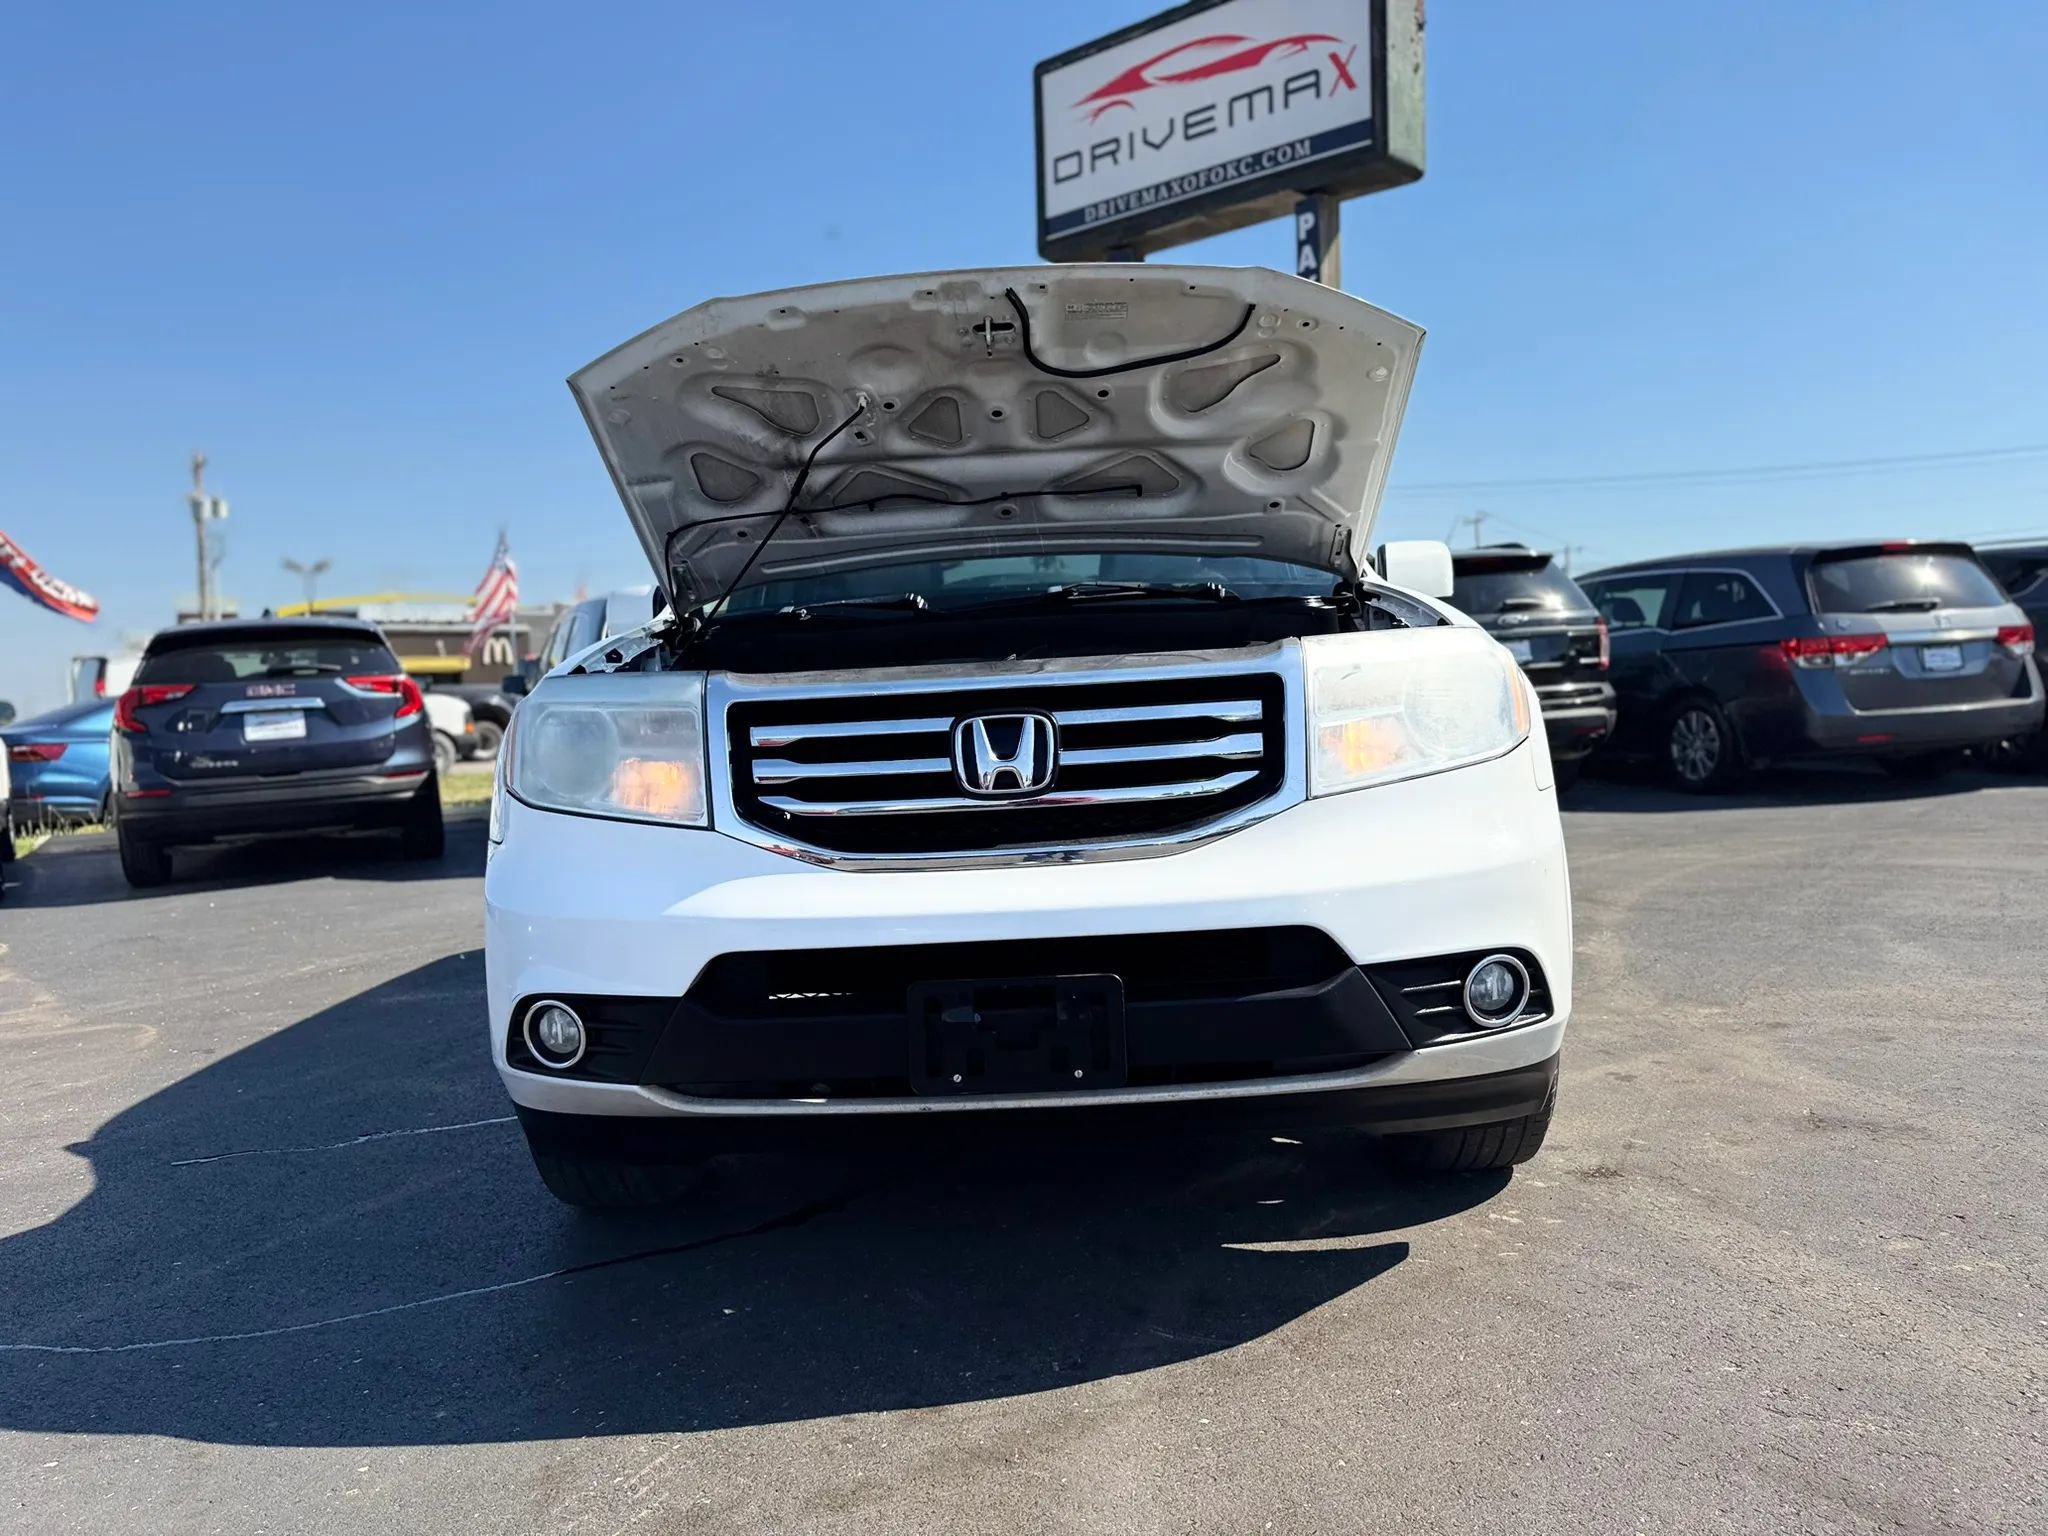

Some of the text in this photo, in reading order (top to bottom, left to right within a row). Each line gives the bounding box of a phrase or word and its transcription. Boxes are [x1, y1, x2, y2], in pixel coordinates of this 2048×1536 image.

[1053, 44, 1358, 185] DRIVEMAX
[1083, 138, 1313, 224] DRIVEMAXOFOKC.COM
[1299, 210, 1318, 281] PA
